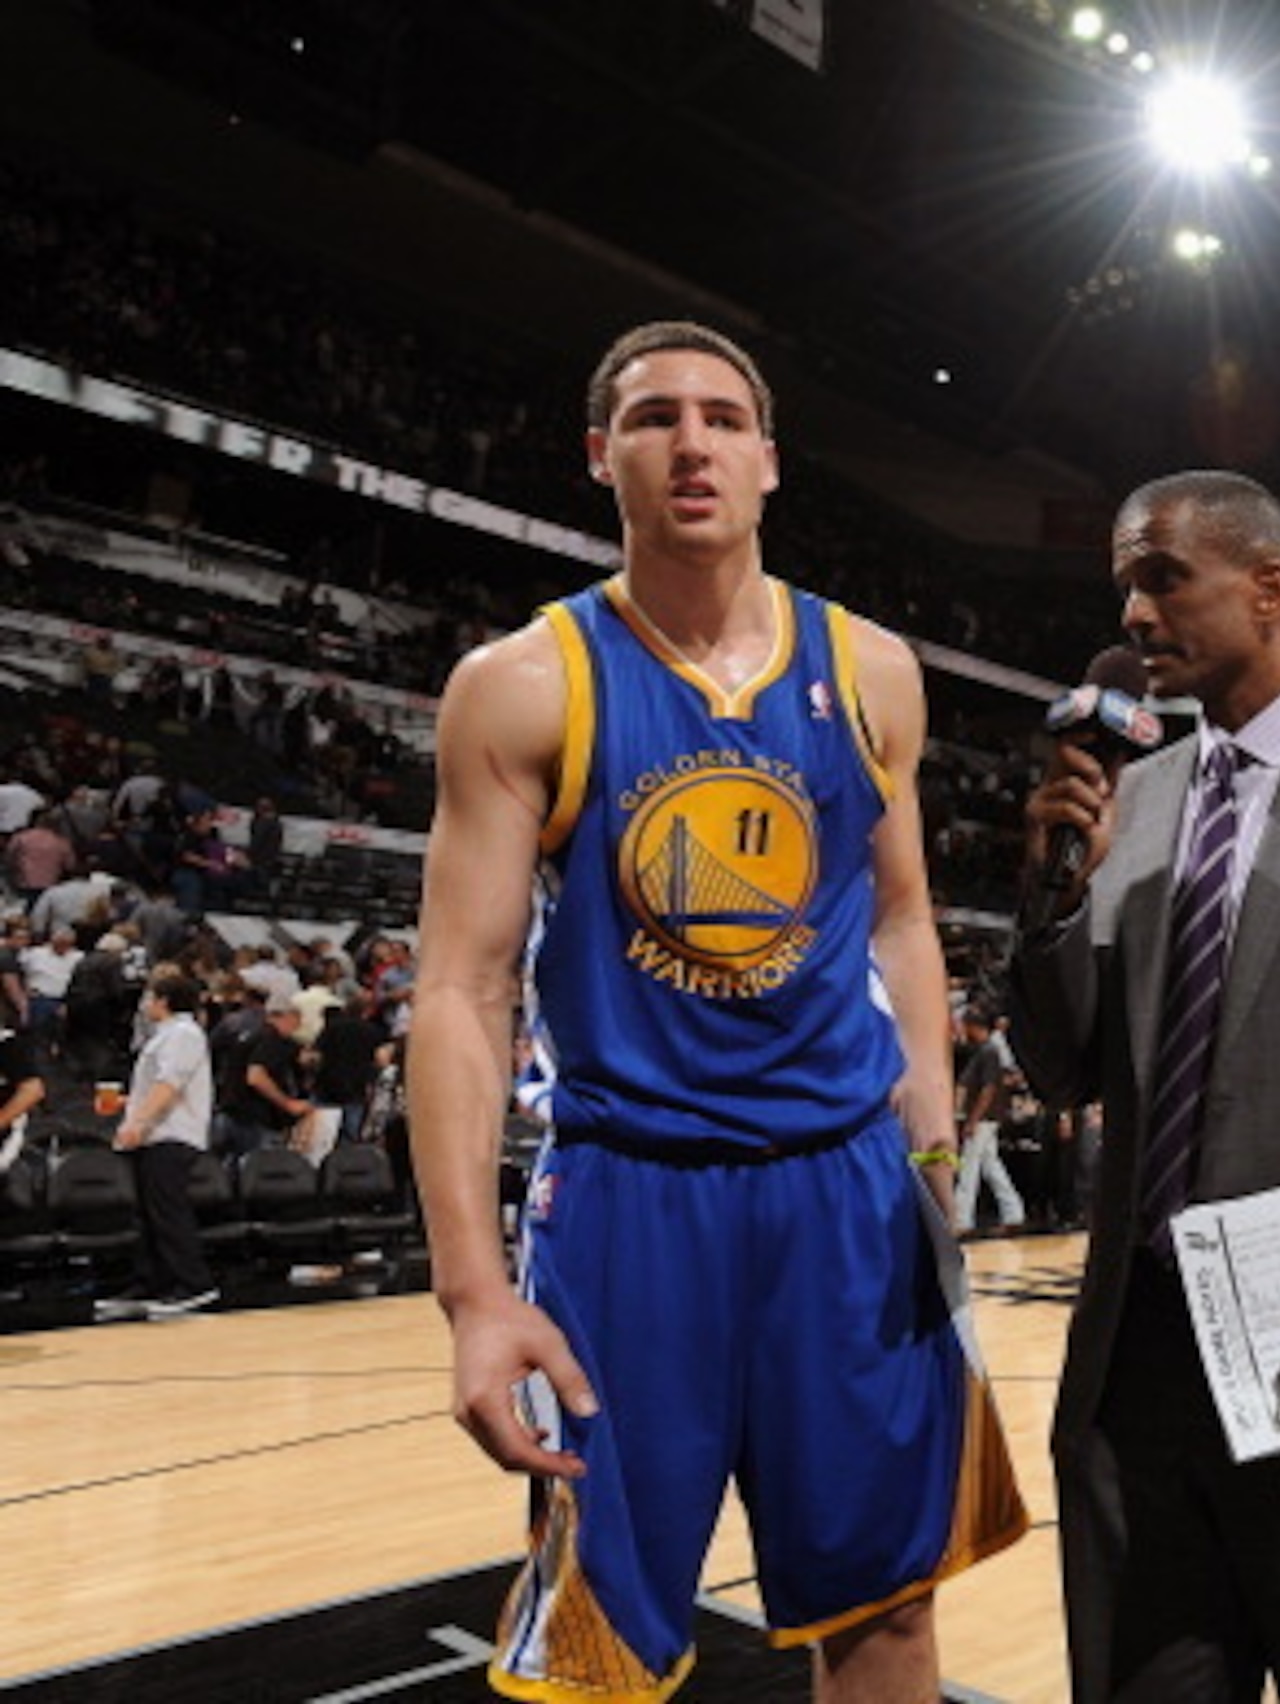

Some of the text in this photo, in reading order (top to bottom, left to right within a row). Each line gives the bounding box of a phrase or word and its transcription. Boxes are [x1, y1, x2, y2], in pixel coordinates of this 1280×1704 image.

[332, 454, 427, 513] THE
[618, 749, 741, 811] GOLDEN
[734, 808, 770, 856] 11
